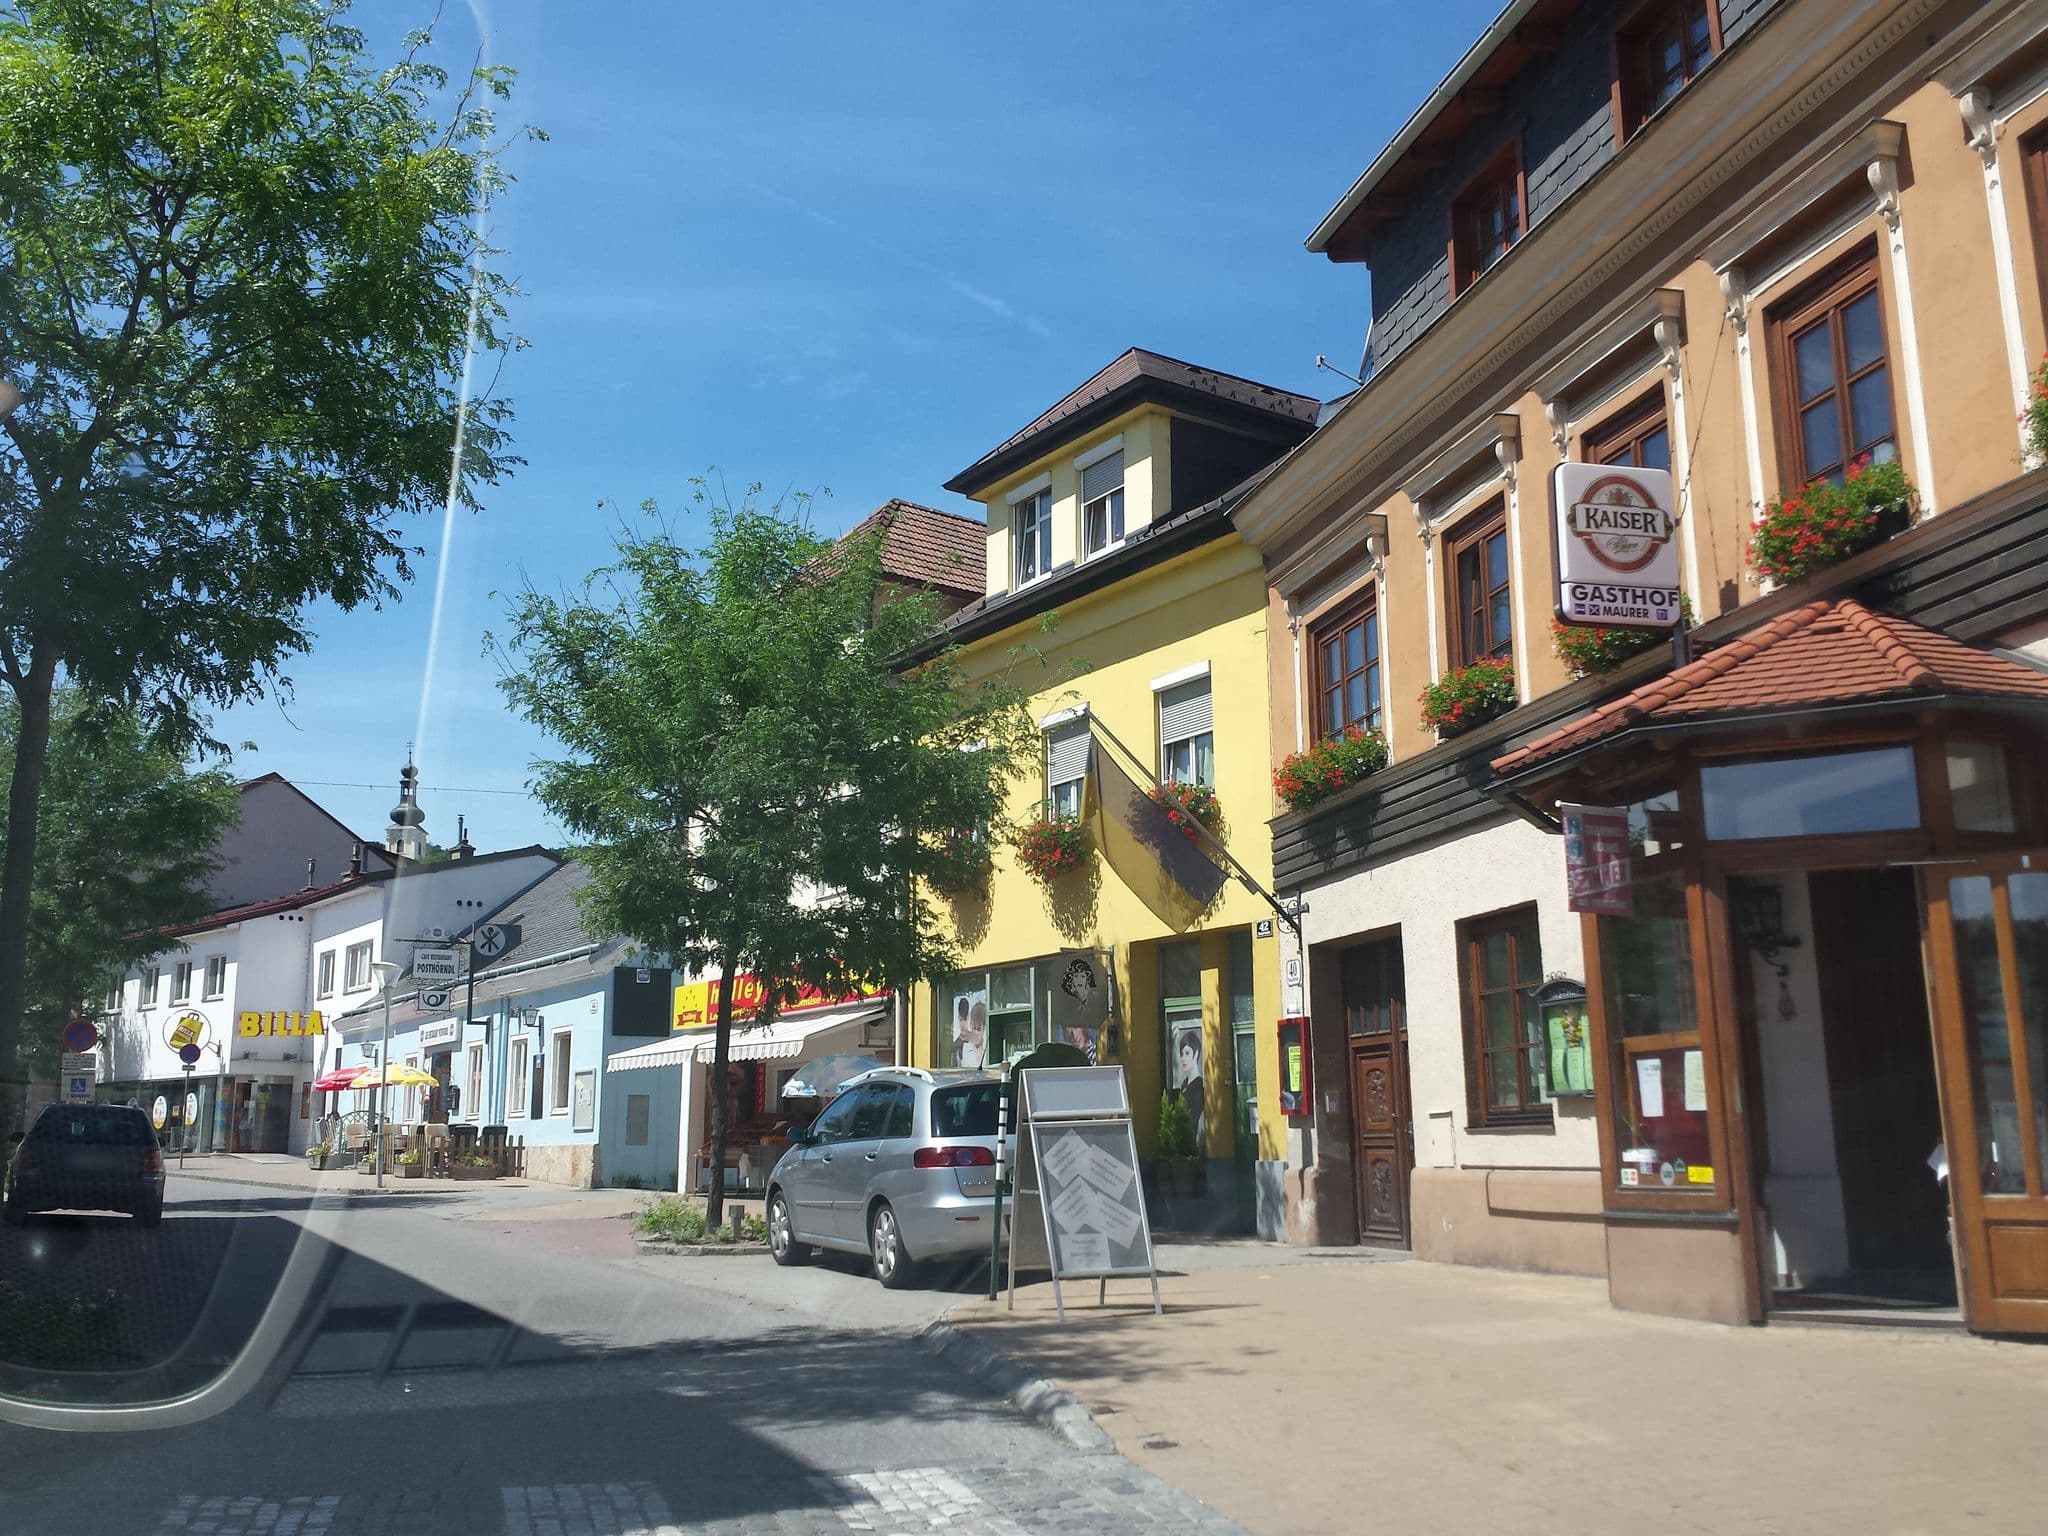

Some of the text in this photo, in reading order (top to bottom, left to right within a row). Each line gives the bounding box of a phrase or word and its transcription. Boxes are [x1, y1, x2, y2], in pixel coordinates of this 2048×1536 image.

[1584, 507, 1658, 533] KAISER
[1571, 585, 1678, 607] GASTHOF
[1603, 605, 1649, 618] MAURER
[1258, 922, 1269, 931] 42
[417, 961, 455, 974] POSTHÖRNDL
[710, 978, 763, 1004] hlley
[178, 1025, 194, 1037] BILLA
[240, 1010, 324, 1037] BILLA
